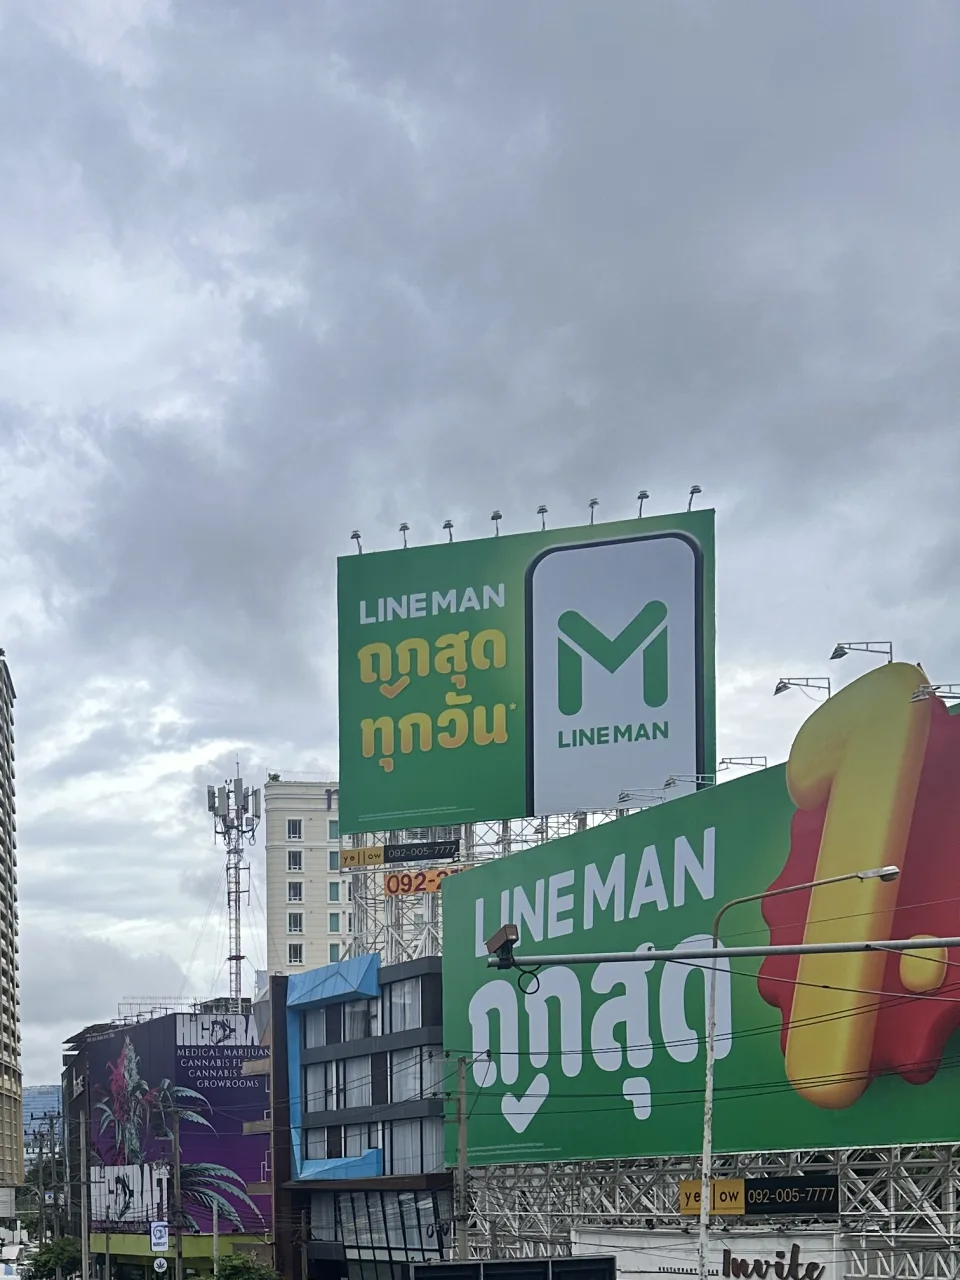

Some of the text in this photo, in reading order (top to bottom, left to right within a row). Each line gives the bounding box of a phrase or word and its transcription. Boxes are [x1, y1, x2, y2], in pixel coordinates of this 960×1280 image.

[343, 845, 456, 865] yellow 092-005-7777
[176, 1048, 220, 1056] MEDICAL
[181, 1058, 230, 1067] CANNABIS
[188, 1069, 238, 1077] CANNABIS
[196, 1079, 260, 1088] GROWROOMS
[684, 1184, 836, 1211] yelow 092-005-7777
[658, 1266, 698, 1274] RESTAURANT
